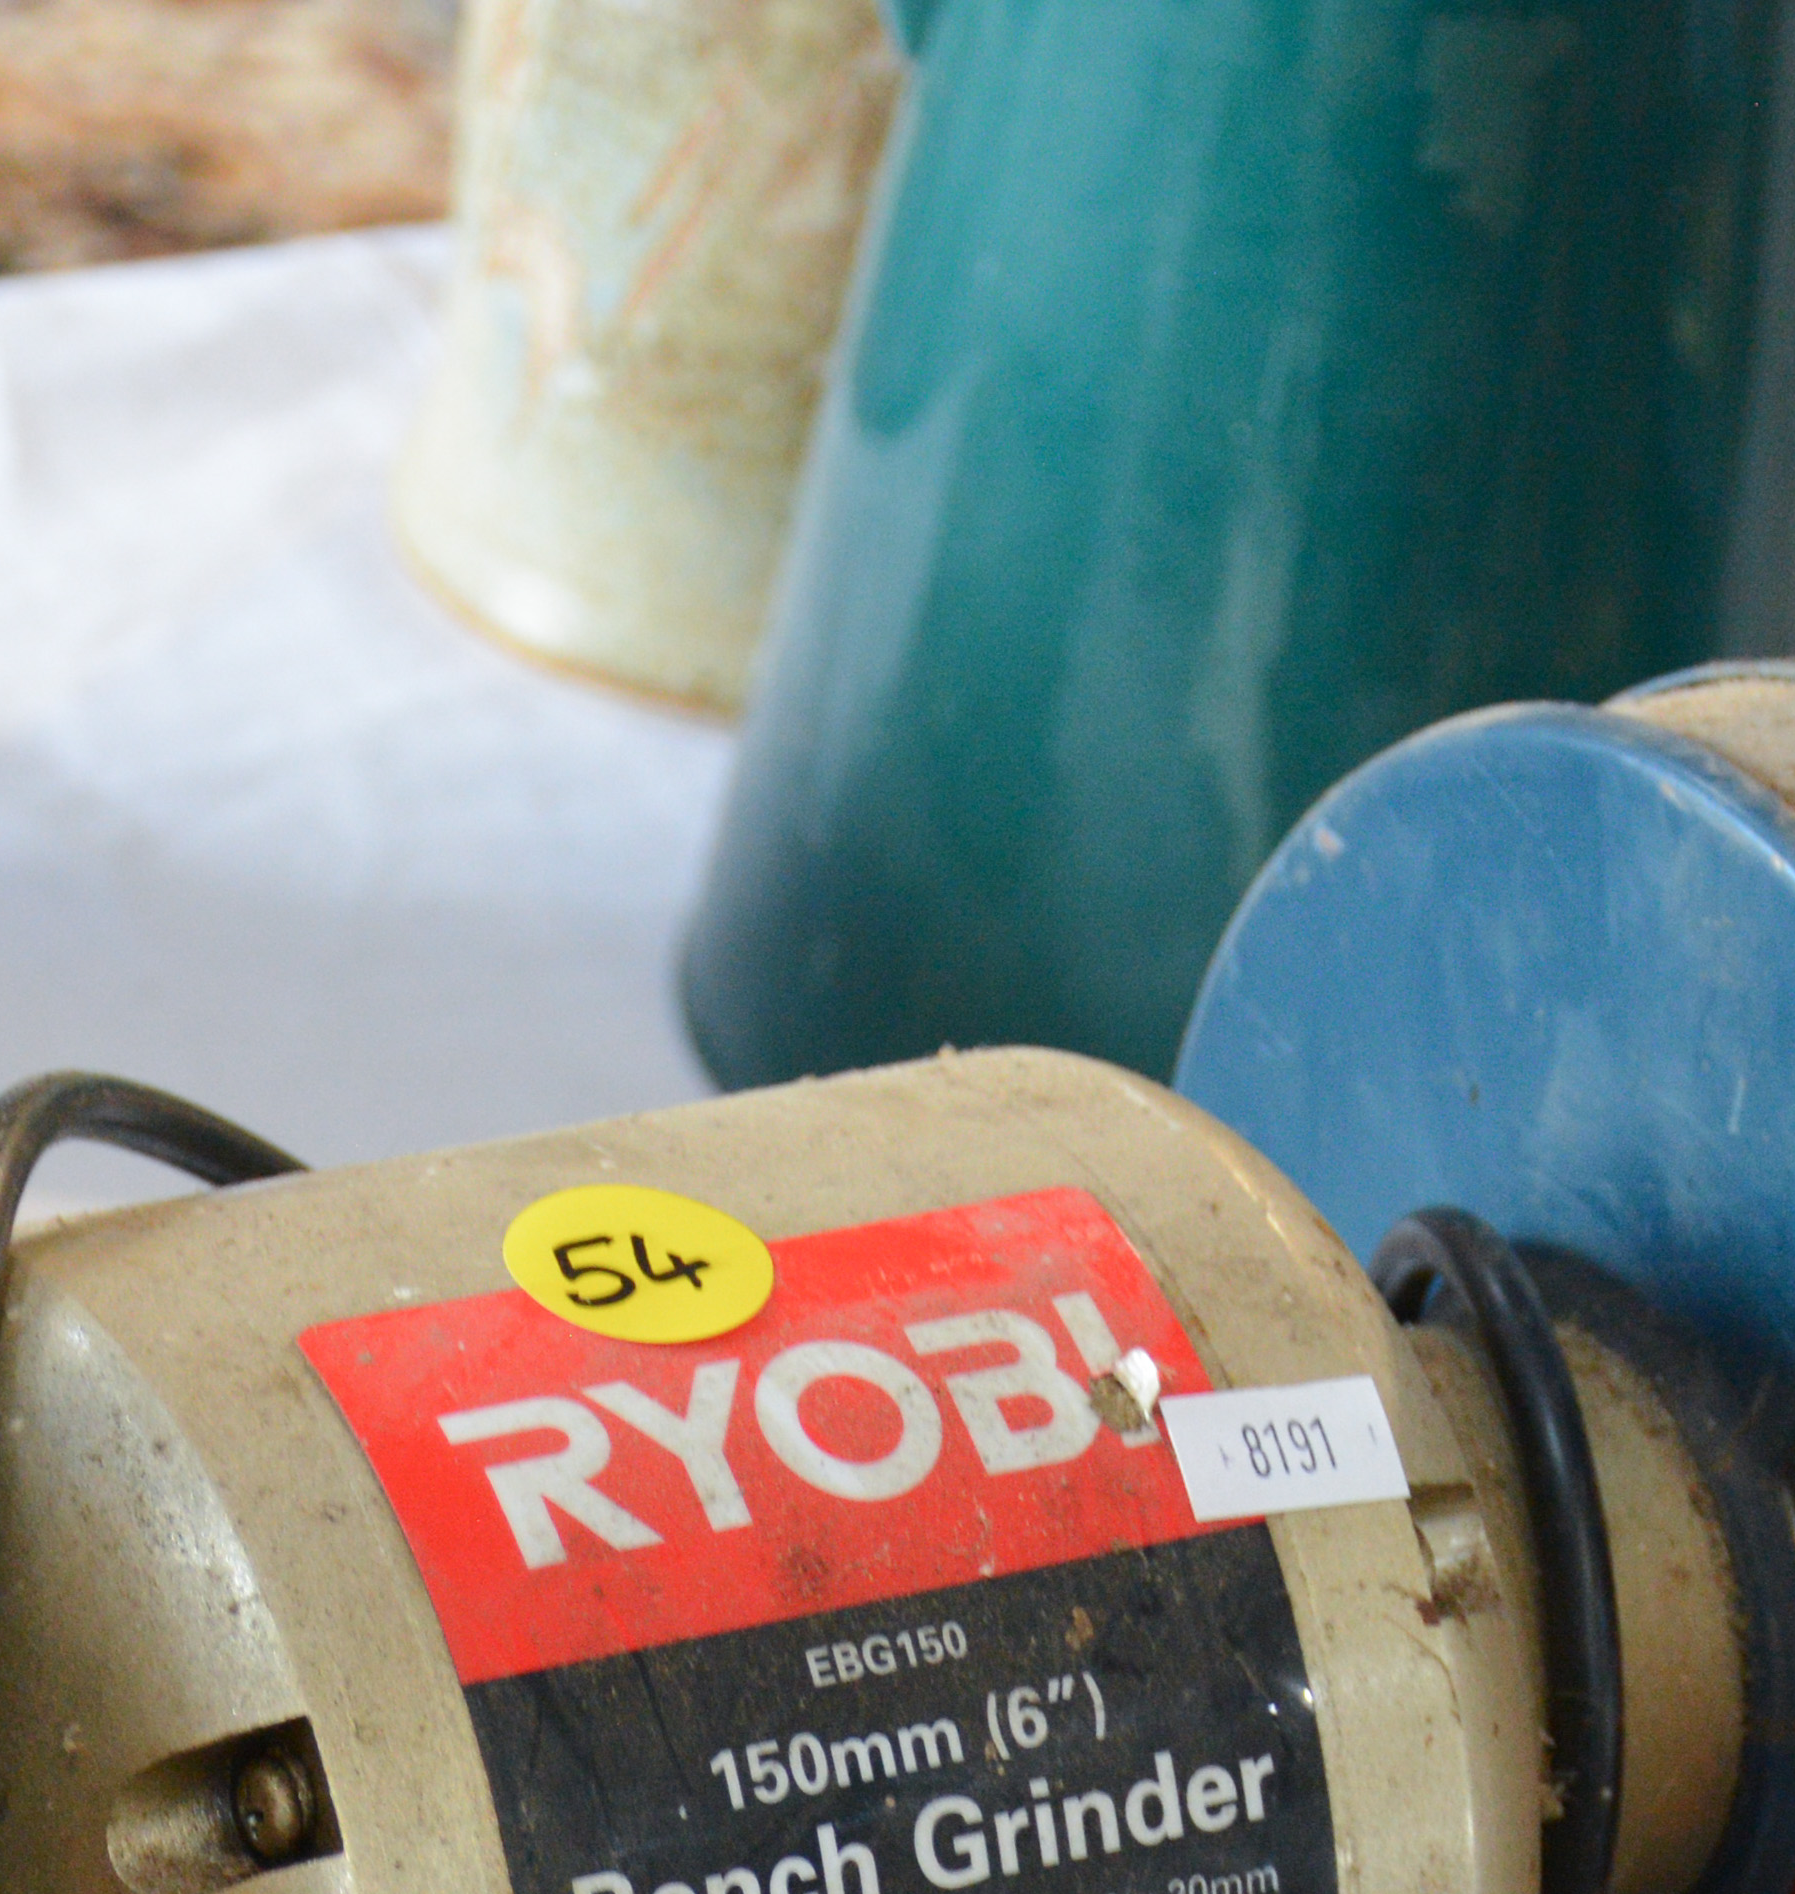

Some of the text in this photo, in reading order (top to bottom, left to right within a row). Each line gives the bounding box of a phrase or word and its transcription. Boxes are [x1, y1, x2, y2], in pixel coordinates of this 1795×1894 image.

[552, 1236, 710, 1308] 54
[437, 1290, 1161, 1571] RYOBI
[1241, 1416, 1337, 1478] 8191
[805, 1620, 967, 1688] EBG150
[709, 1716, 964, 1810] 150mm
[913, 1751, 1276, 1890] Grinder
